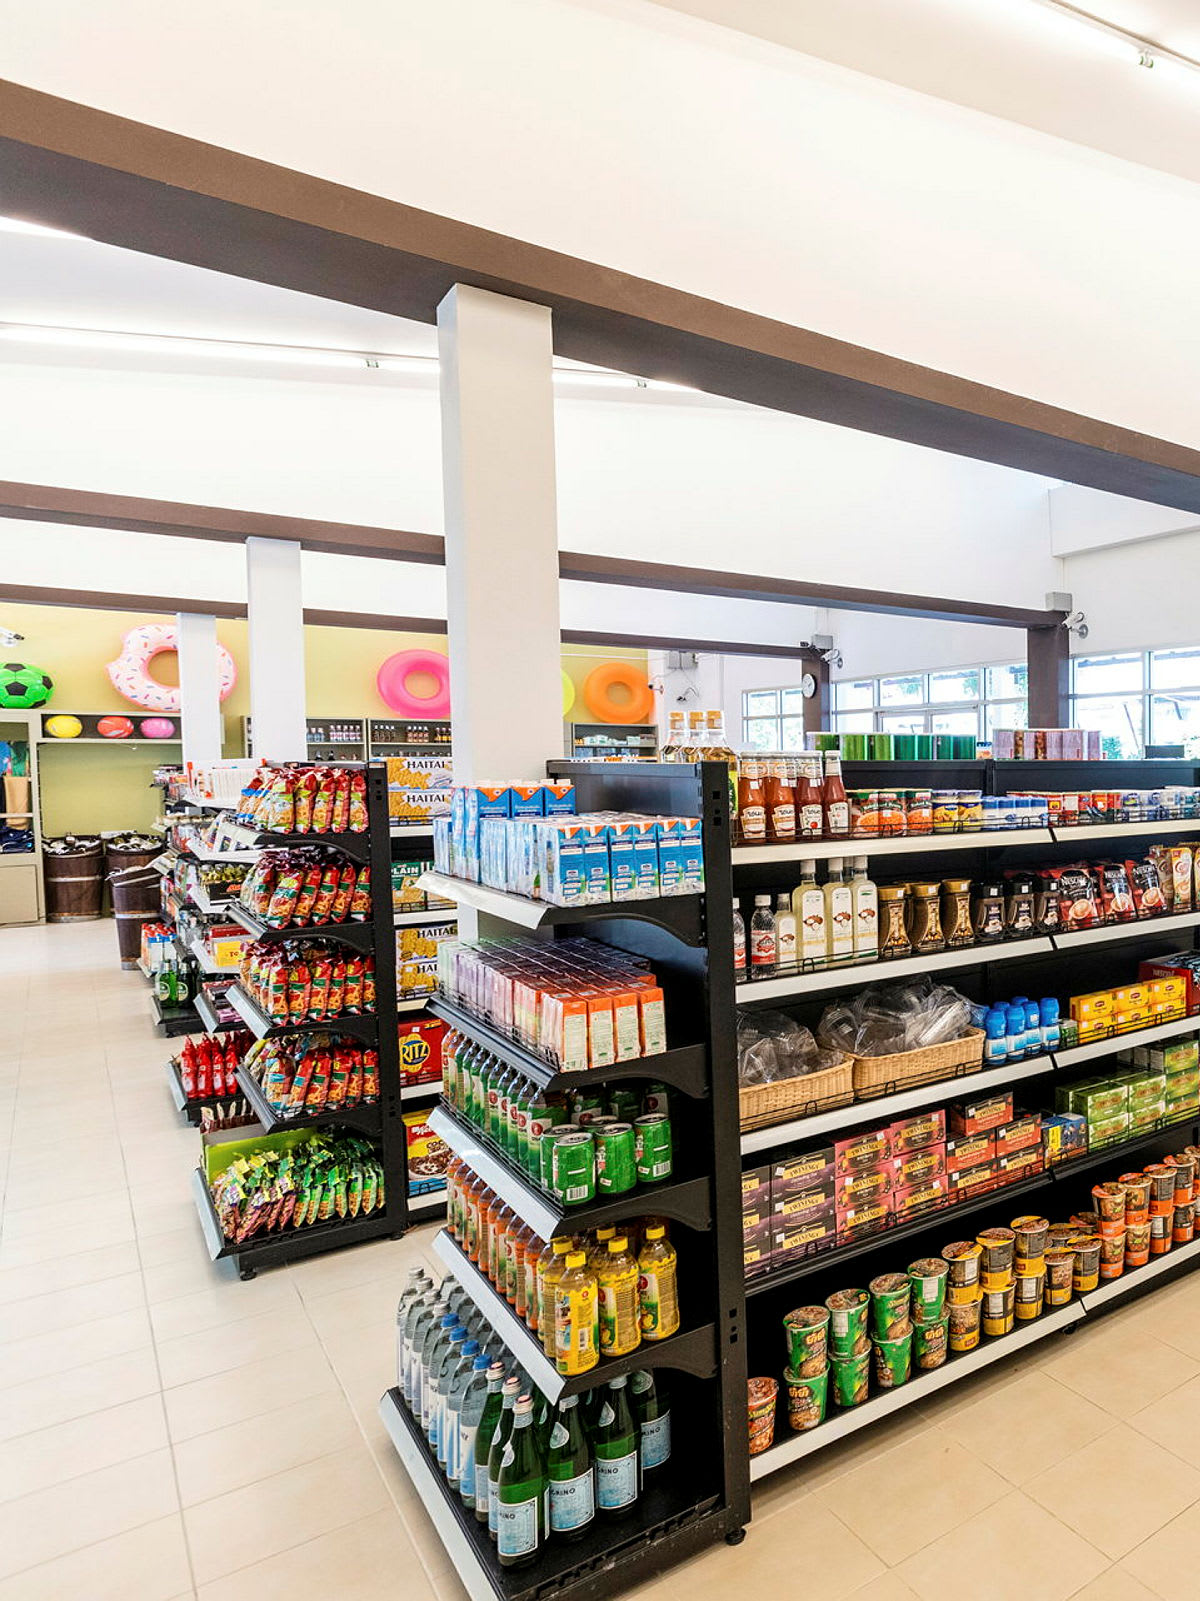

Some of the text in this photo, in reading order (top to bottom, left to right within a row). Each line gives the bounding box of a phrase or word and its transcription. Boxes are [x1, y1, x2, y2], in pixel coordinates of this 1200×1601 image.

[407, 760, 445, 769] HAITAI
[407, 794, 445, 803] HAITAI
[391, 866, 419, 875] LAIN
[400, 1042, 429, 1063] RITZ
